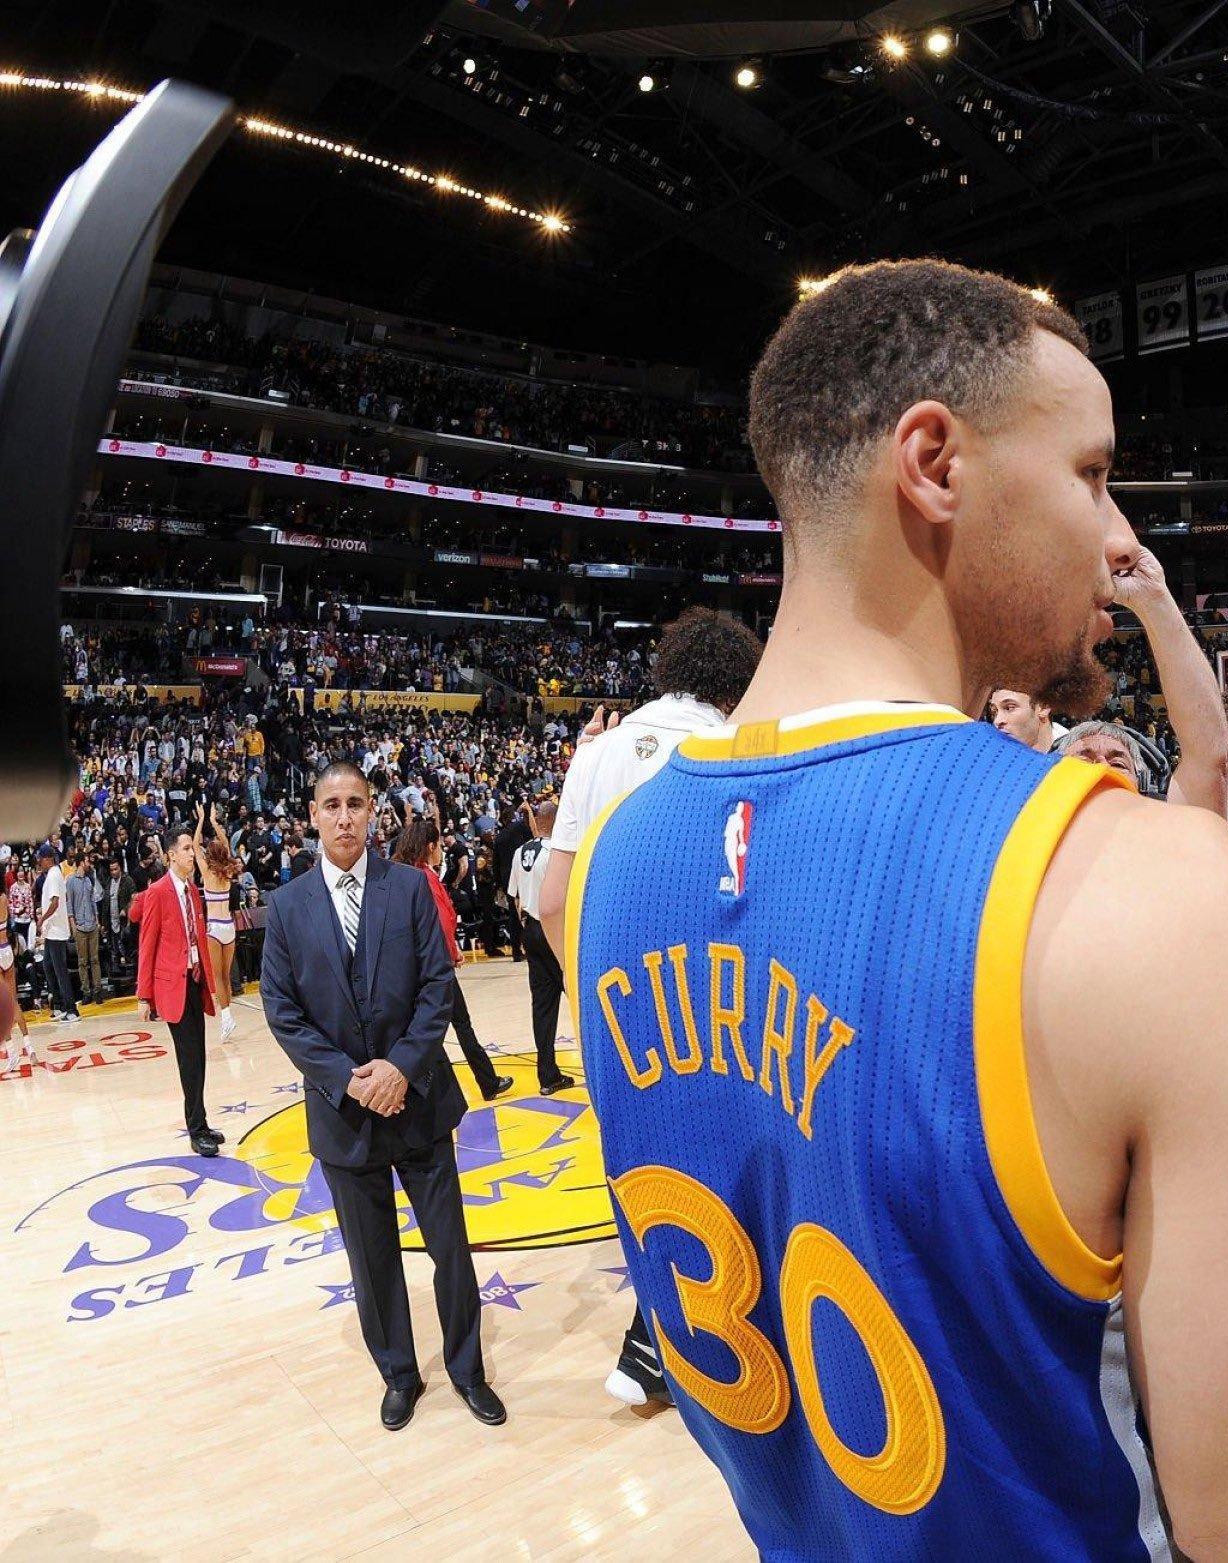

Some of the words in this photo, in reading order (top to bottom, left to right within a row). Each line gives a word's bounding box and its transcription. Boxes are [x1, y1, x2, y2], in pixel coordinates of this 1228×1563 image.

[1143, 301, 1182, 335] 99
[325, 536, 368, 552] TOYOTA
[437, 552, 470, 564] verizon
[597, 942, 855, 1141] CURRY
[607, 1165, 946, 1516] 30
